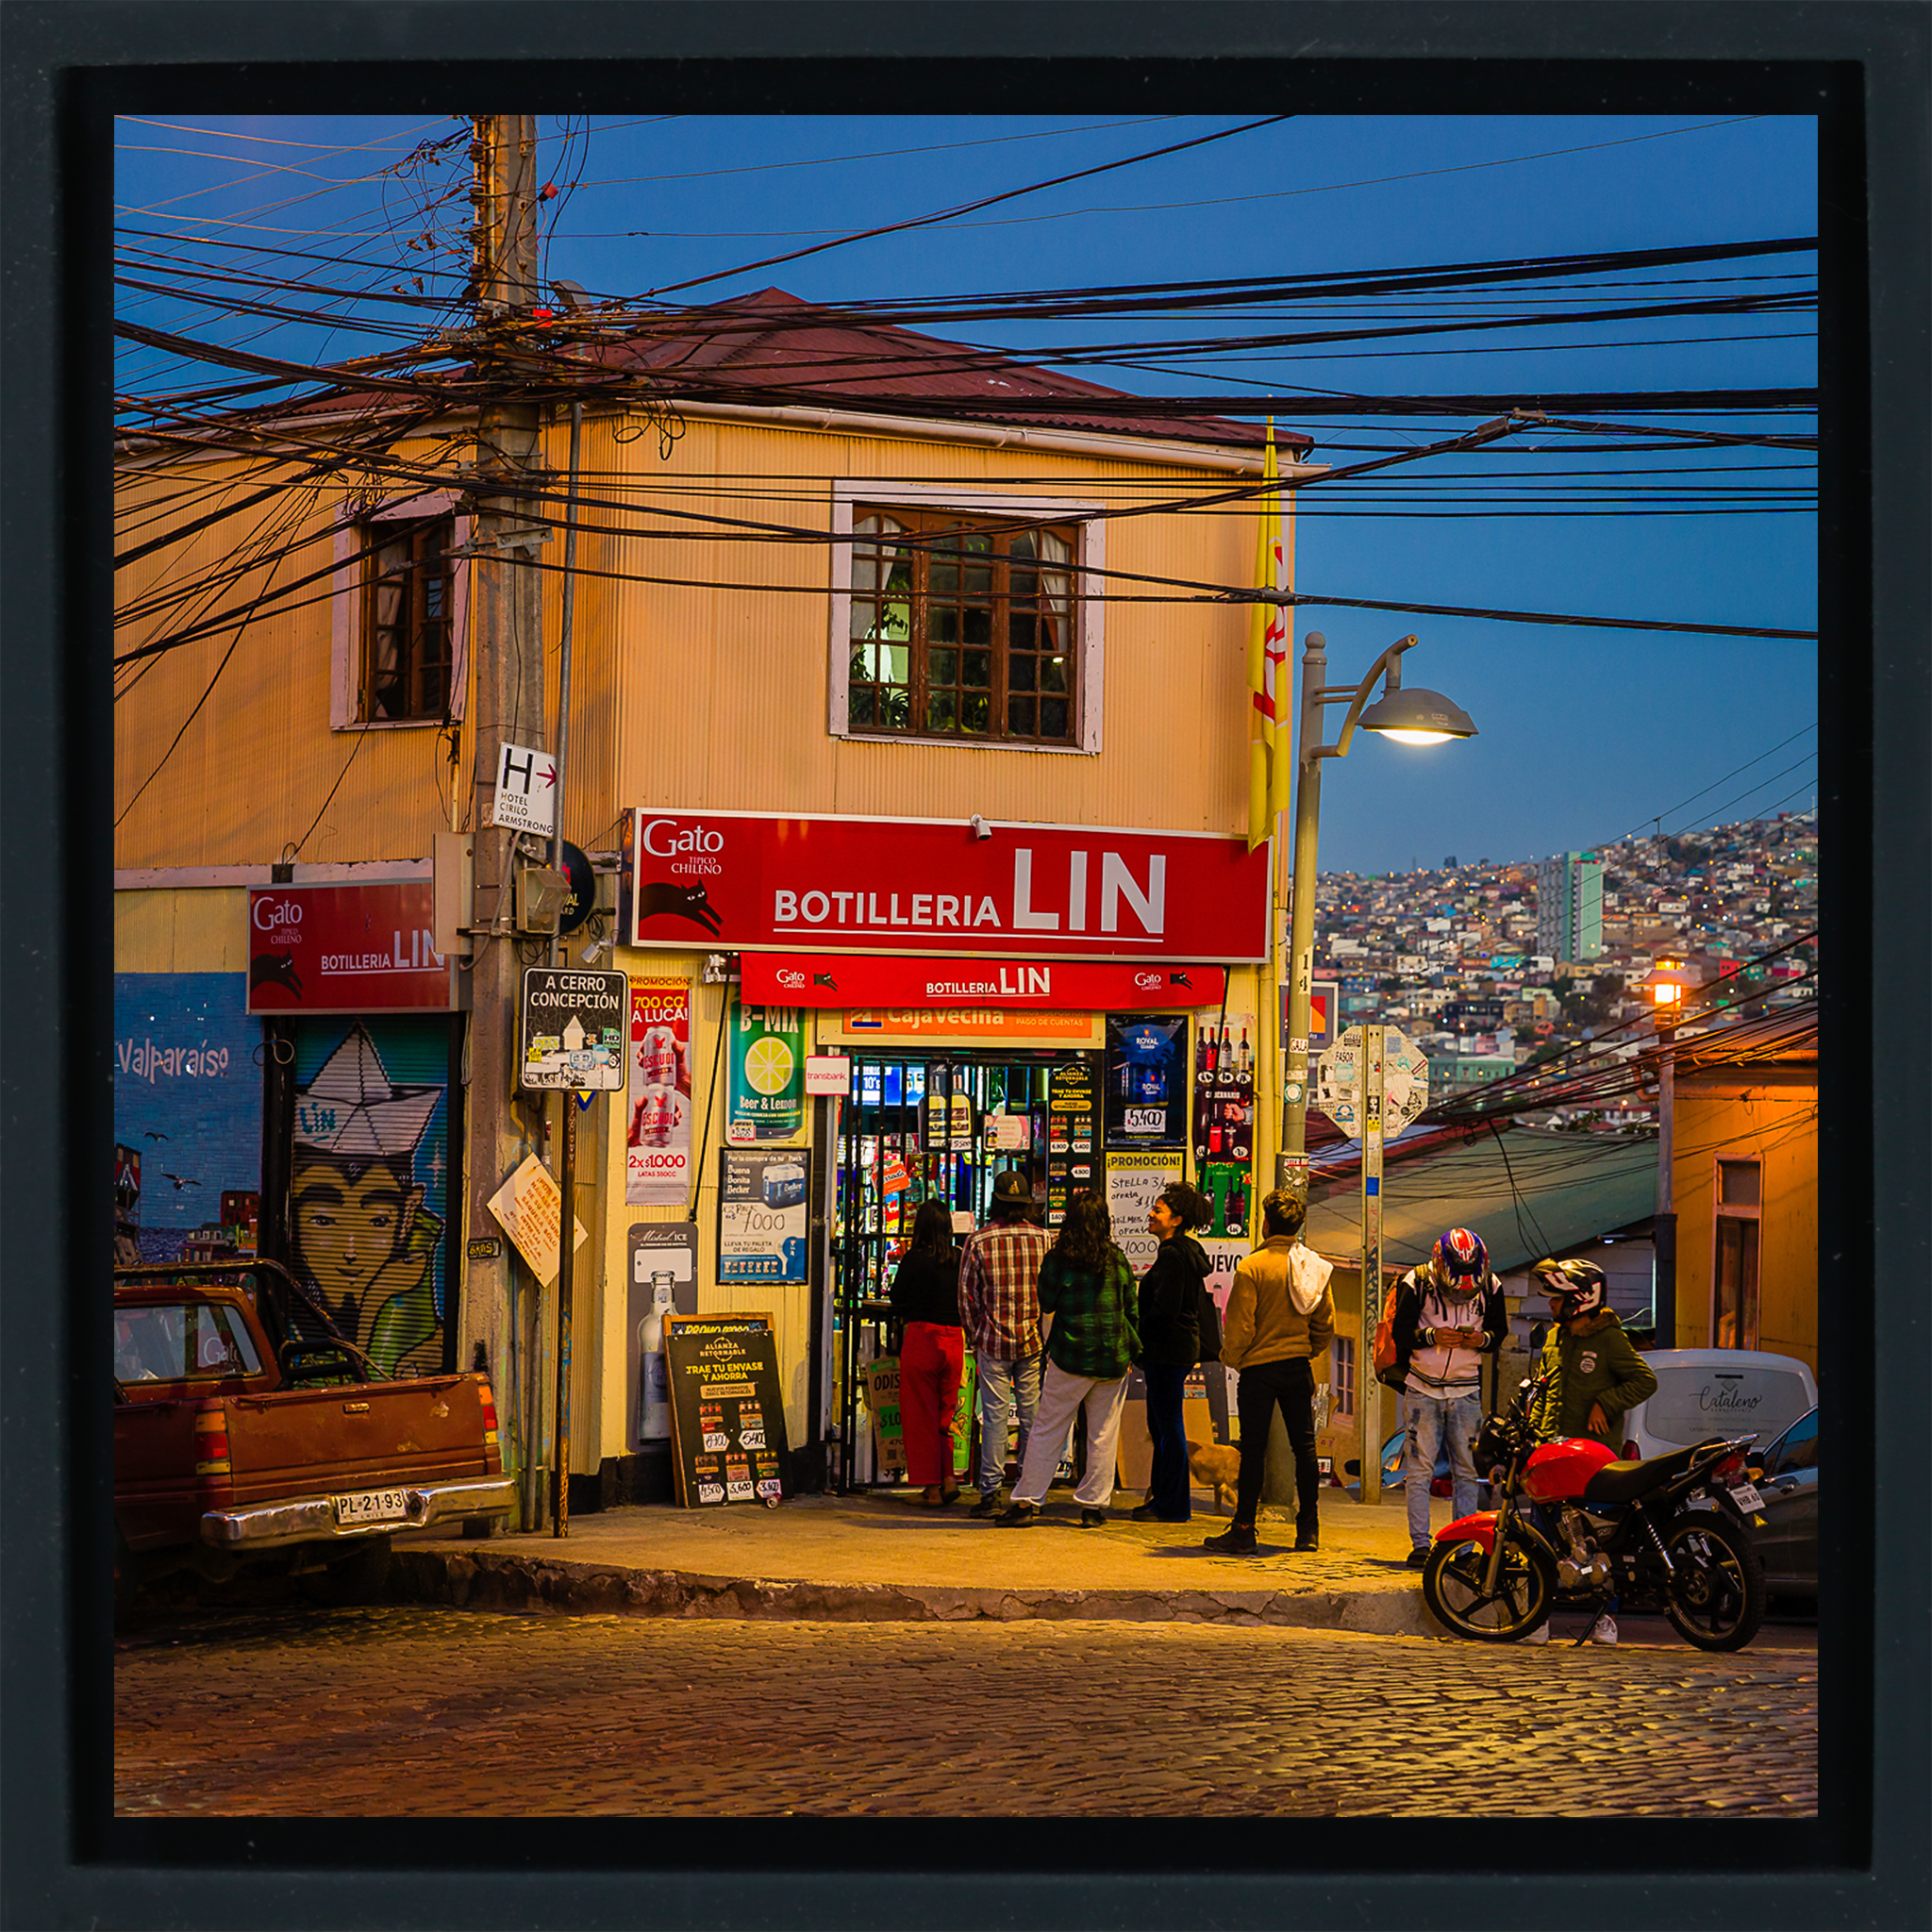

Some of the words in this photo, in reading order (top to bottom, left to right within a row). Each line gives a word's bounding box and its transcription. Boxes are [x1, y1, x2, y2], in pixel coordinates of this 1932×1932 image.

[502, 748, 533, 794] H
[500, 791, 528, 807] HOTEL
[499, 802, 528, 816] CIRILO
[498, 813, 554, 834] ARMSTRONG
[643, 819, 724, 857] Gato
[671, 862, 722, 874] CHILENO
[774, 890, 1001, 927] BOTILLERIA
[1013, 848, 1166, 934] LIN
[254, 896, 303, 931] Gato
[271, 934, 302, 944] CHILENO
[321, 953, 391, 970] BOTILLERIA
[394, 929, 445, 968] LIN
[545, 975, 557, 990] A
[560, 975, 606, 991] CERRO
[776, 969, 805, 983] Gato
[926, 982, 998, 994] BOTILLERIA
[1000, 967, 1051, 994] LIN
[1134, 972, 1162, 986] Gato
[530, 991, 620, 1009] CONCEPCIÓN
[634, 996, 661, 1008] 700
[662, 995, 685, 1008] CC
[631, 1010, 642, 1024] A
[644, 1008, 689, 1023] LUCA!
[740, 1005, 800, 1034] B-MIX
[118, 1038, 229, 1085] Valparaíso
[740, 1095, 759, 1109] Beer
[760, 1096, 769, 1110] &
[770, 1097, 797, 1110] Lemon
[1107, 1155, 1181, 1169] ¡PROMOCIÓN!
[686, 1364, 711, 1374] TRAE
[712, 1363, 725, 1373] TU
[726, 1361, 764, 1372] ENVASE
[711, 1372, 749, 1381] AHORRA
